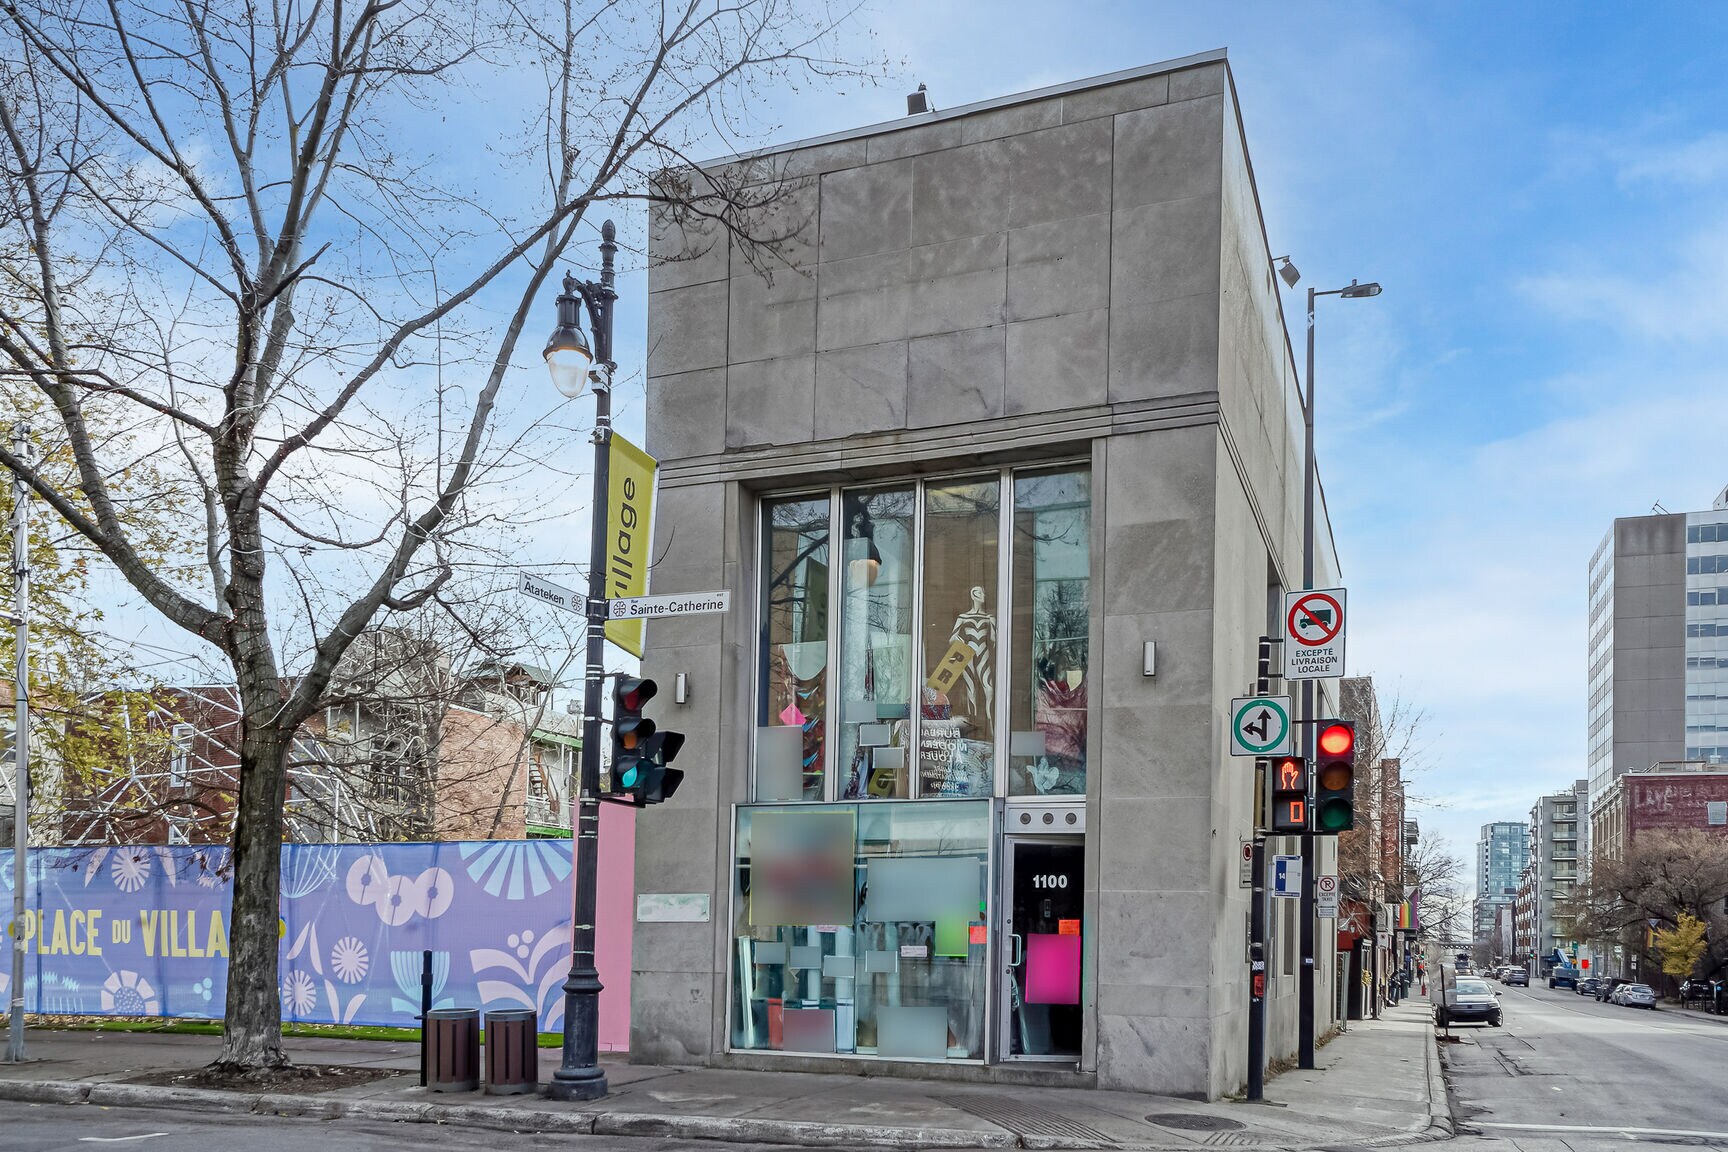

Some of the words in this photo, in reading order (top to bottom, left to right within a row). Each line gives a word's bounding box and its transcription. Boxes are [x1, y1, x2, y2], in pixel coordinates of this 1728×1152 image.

[611, 477, 637, 598] illage
[524, 581, 565, 605] Atateken
[630, 599, 724, 616] Sainte-Catherine
[1295, 647, 1334, 657] EXCEPTÉ
[1291, 656, 1338, 666] LIVRAISON
[1297, 664, 1330, 674] LOCALE
[1032, 874, 1068, 889] 1100
[1278, 872, 1286, 880] 14
[24, 909, 102, 956] PLACE
[112, 919, 130, 944] DU
[140, 910, 229, 957] VILLA
